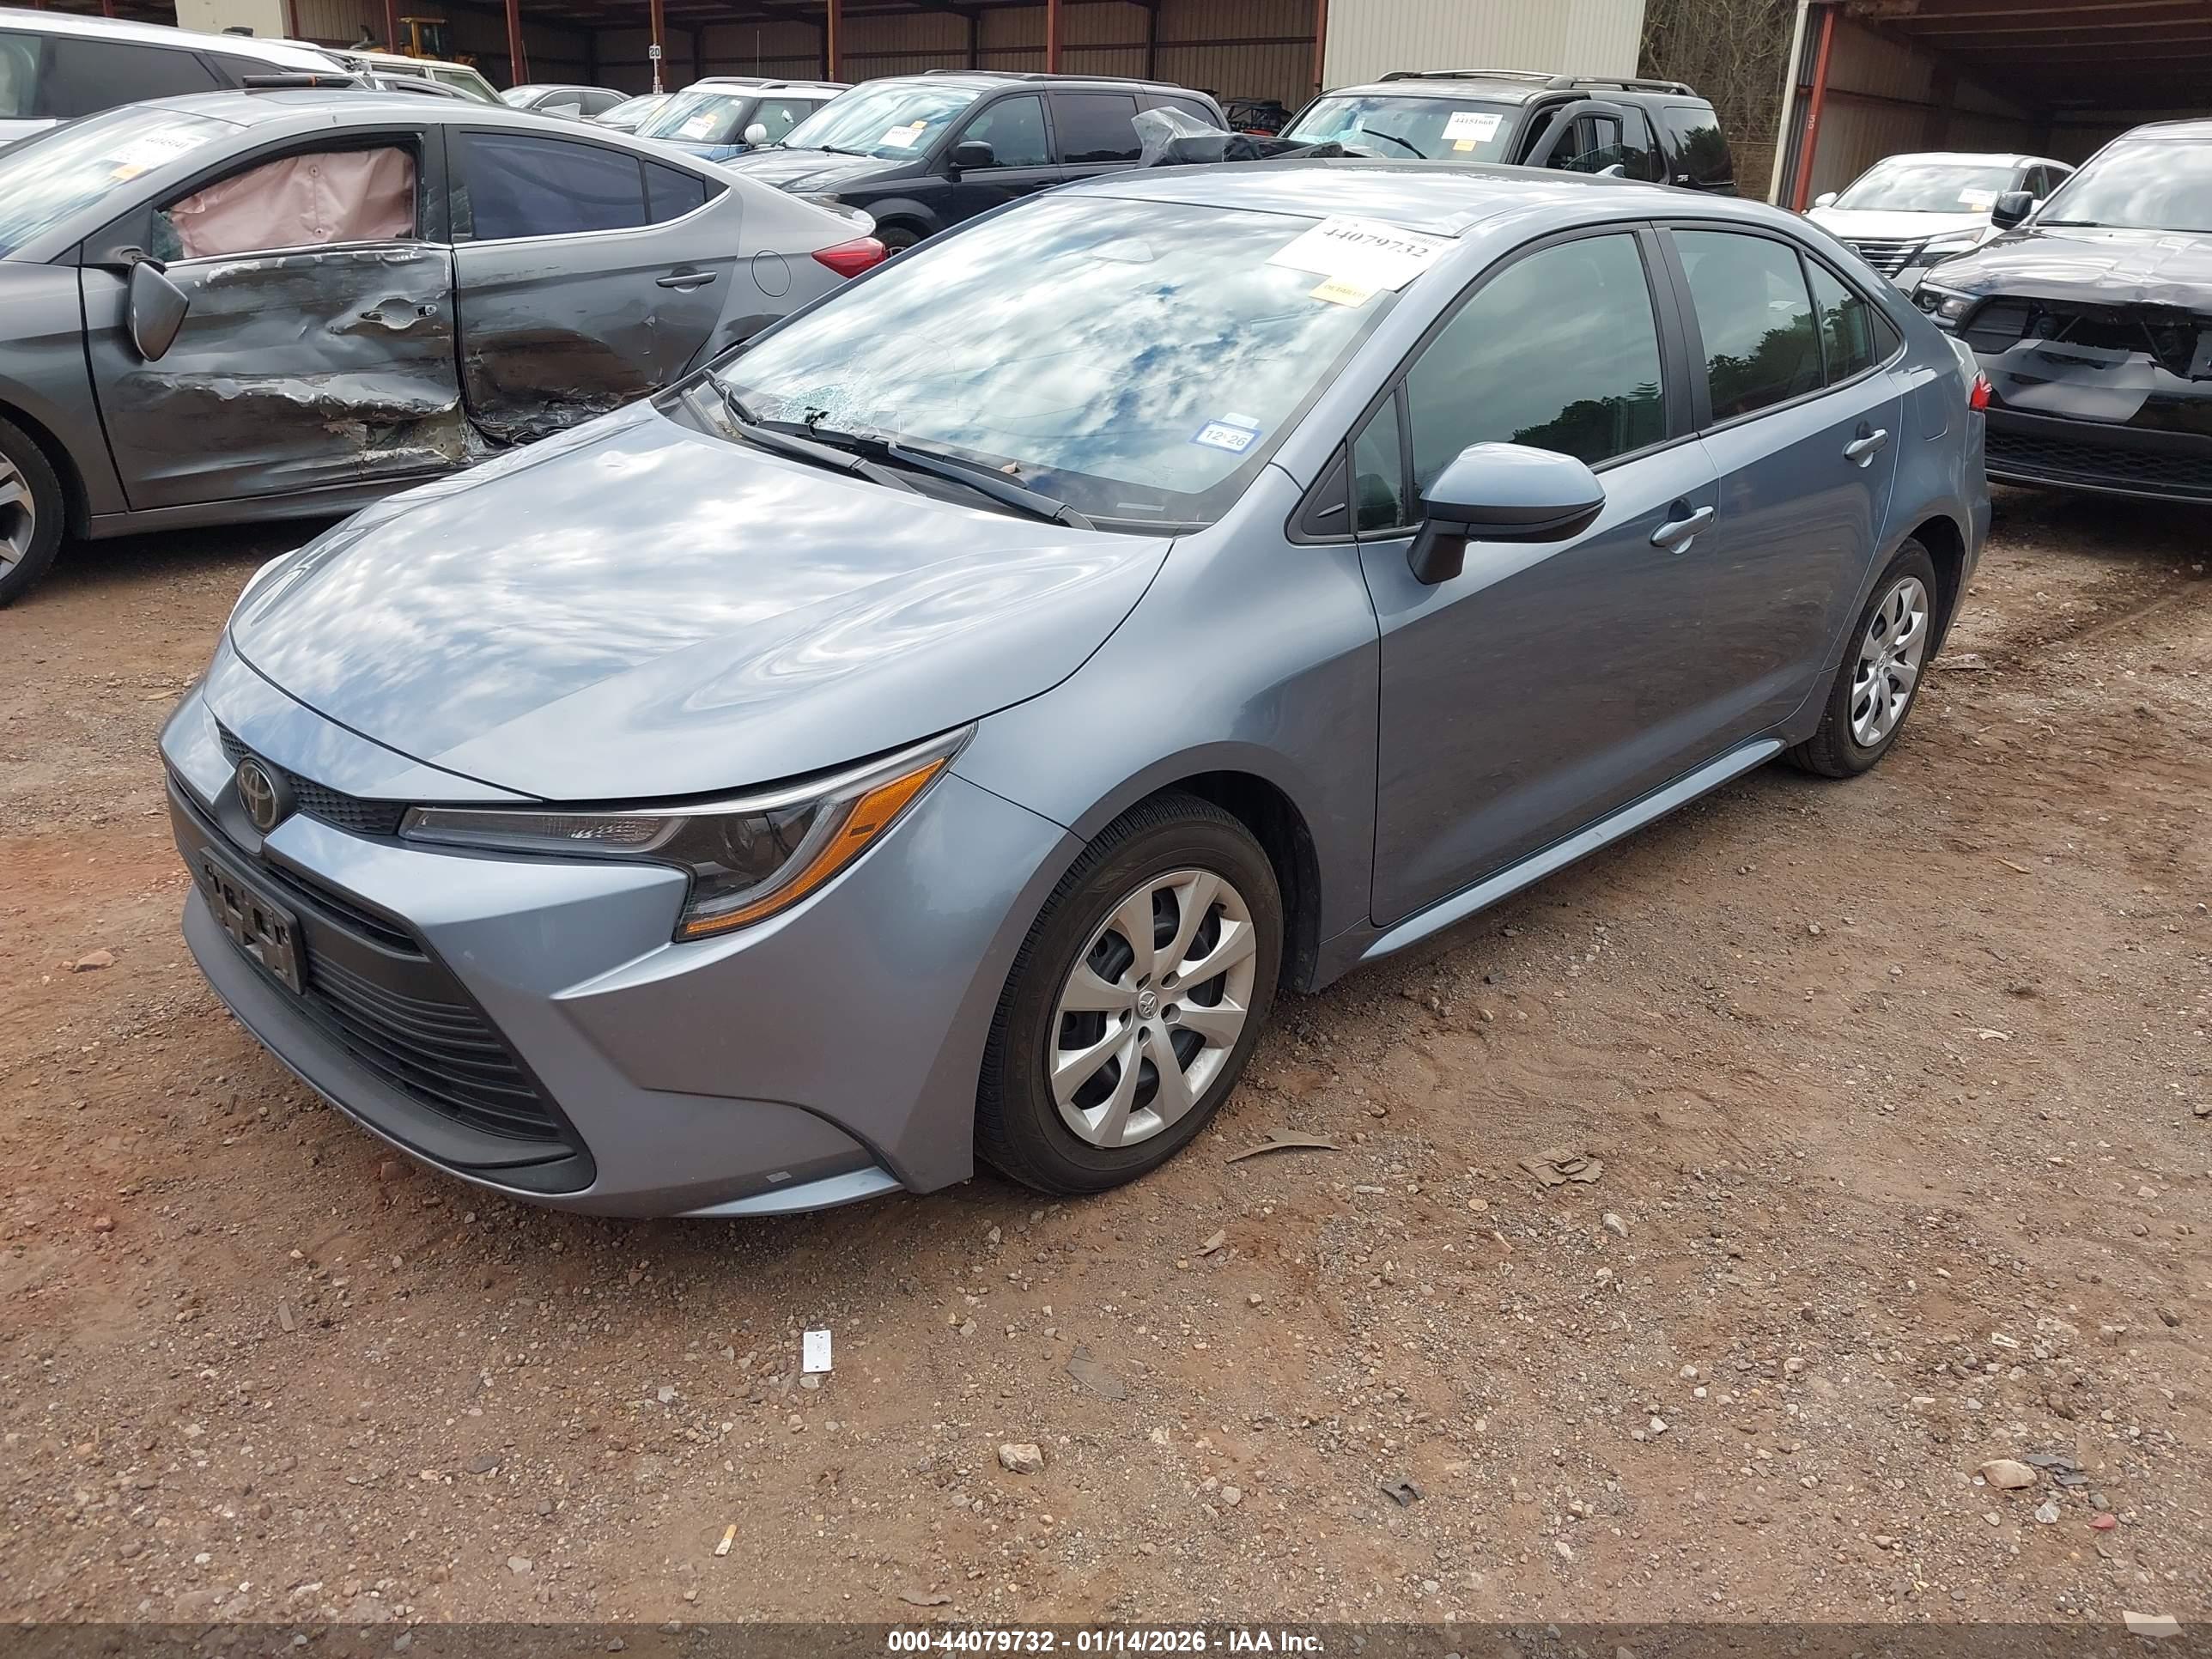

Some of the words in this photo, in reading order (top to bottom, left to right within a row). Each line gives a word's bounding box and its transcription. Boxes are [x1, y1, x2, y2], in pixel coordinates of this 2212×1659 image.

[649, 47, 660, 57] 20
[1323, 228, 1429, 258] 44079732
[1206, 430, 1224, 441] 12
[1227, 434, 1248, 447] 26
